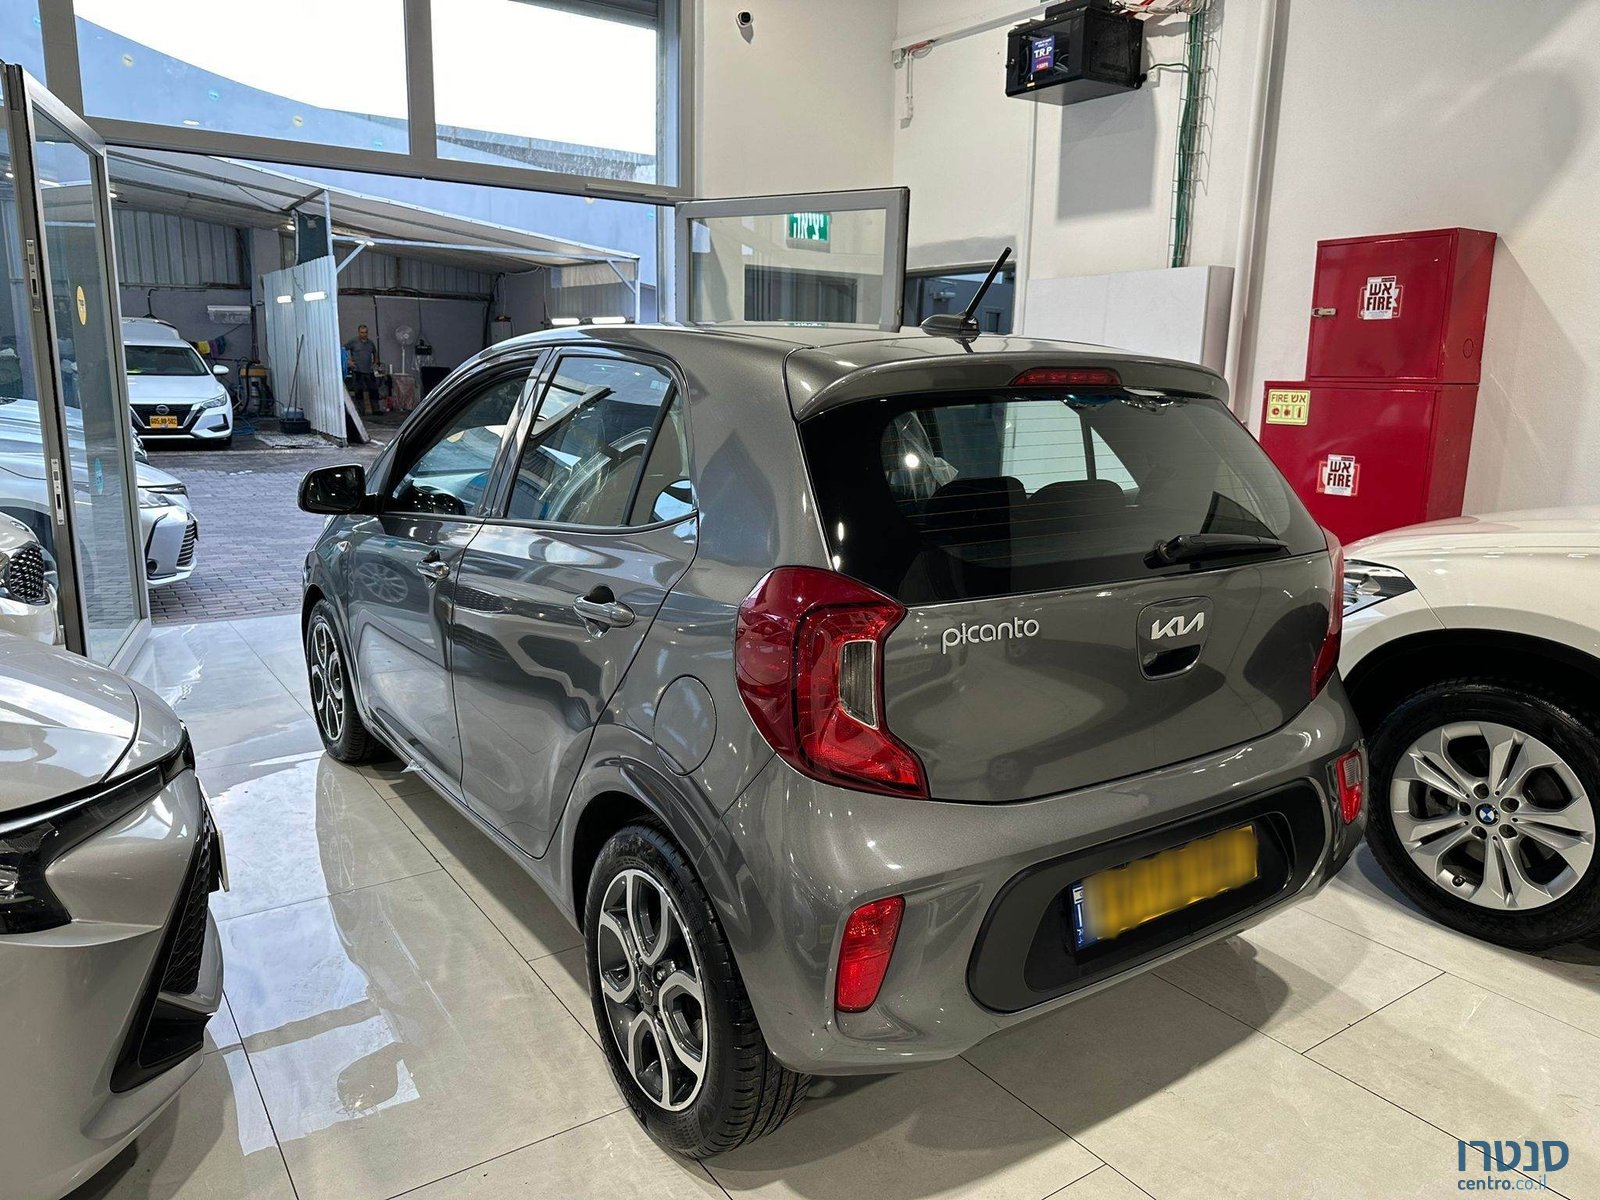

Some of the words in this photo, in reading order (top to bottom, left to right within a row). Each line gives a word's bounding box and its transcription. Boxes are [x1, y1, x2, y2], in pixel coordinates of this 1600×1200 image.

[1369, 282, 1393, 296] אש
[1366, 295, 1393, 311] FIRE
[1271, 393, 1289, 403] FIRE
[1291, 394, 1307, 404] אש
[1330, 461, 1351, 473] אש
[1326, 472, 1352, 488] FIRE
[1150, 611, 1205, 640] KIA
[941, 616, 1040, 654] picanto
